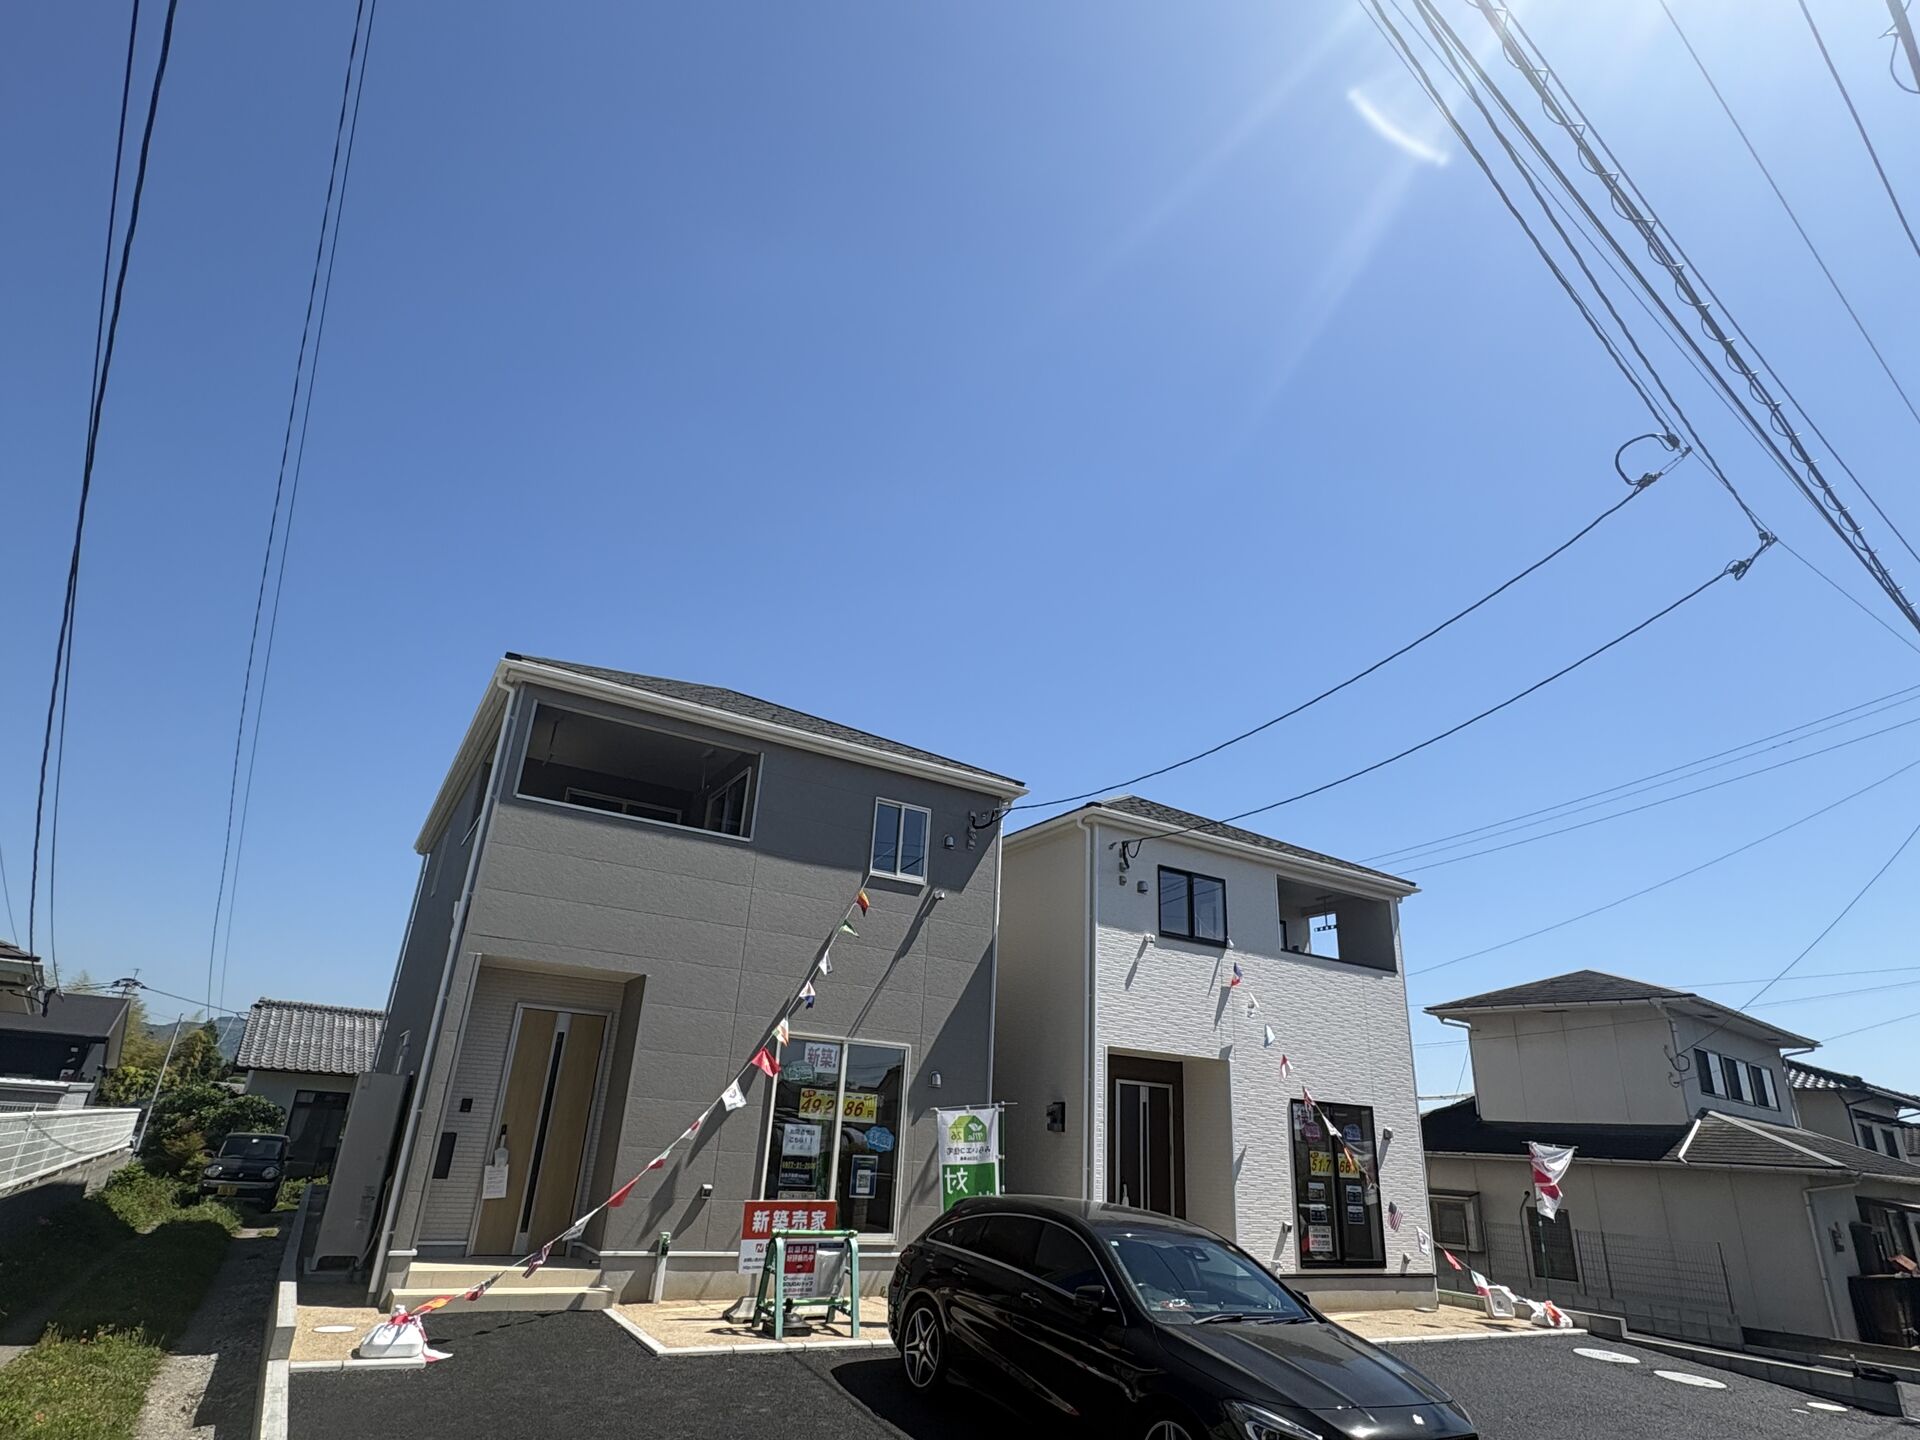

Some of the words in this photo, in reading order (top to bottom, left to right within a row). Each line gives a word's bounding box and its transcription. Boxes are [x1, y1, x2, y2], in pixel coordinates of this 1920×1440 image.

[807, 1047, 838, 1068] 新築!
[752, 1210, 827, 1233] 新築売家
